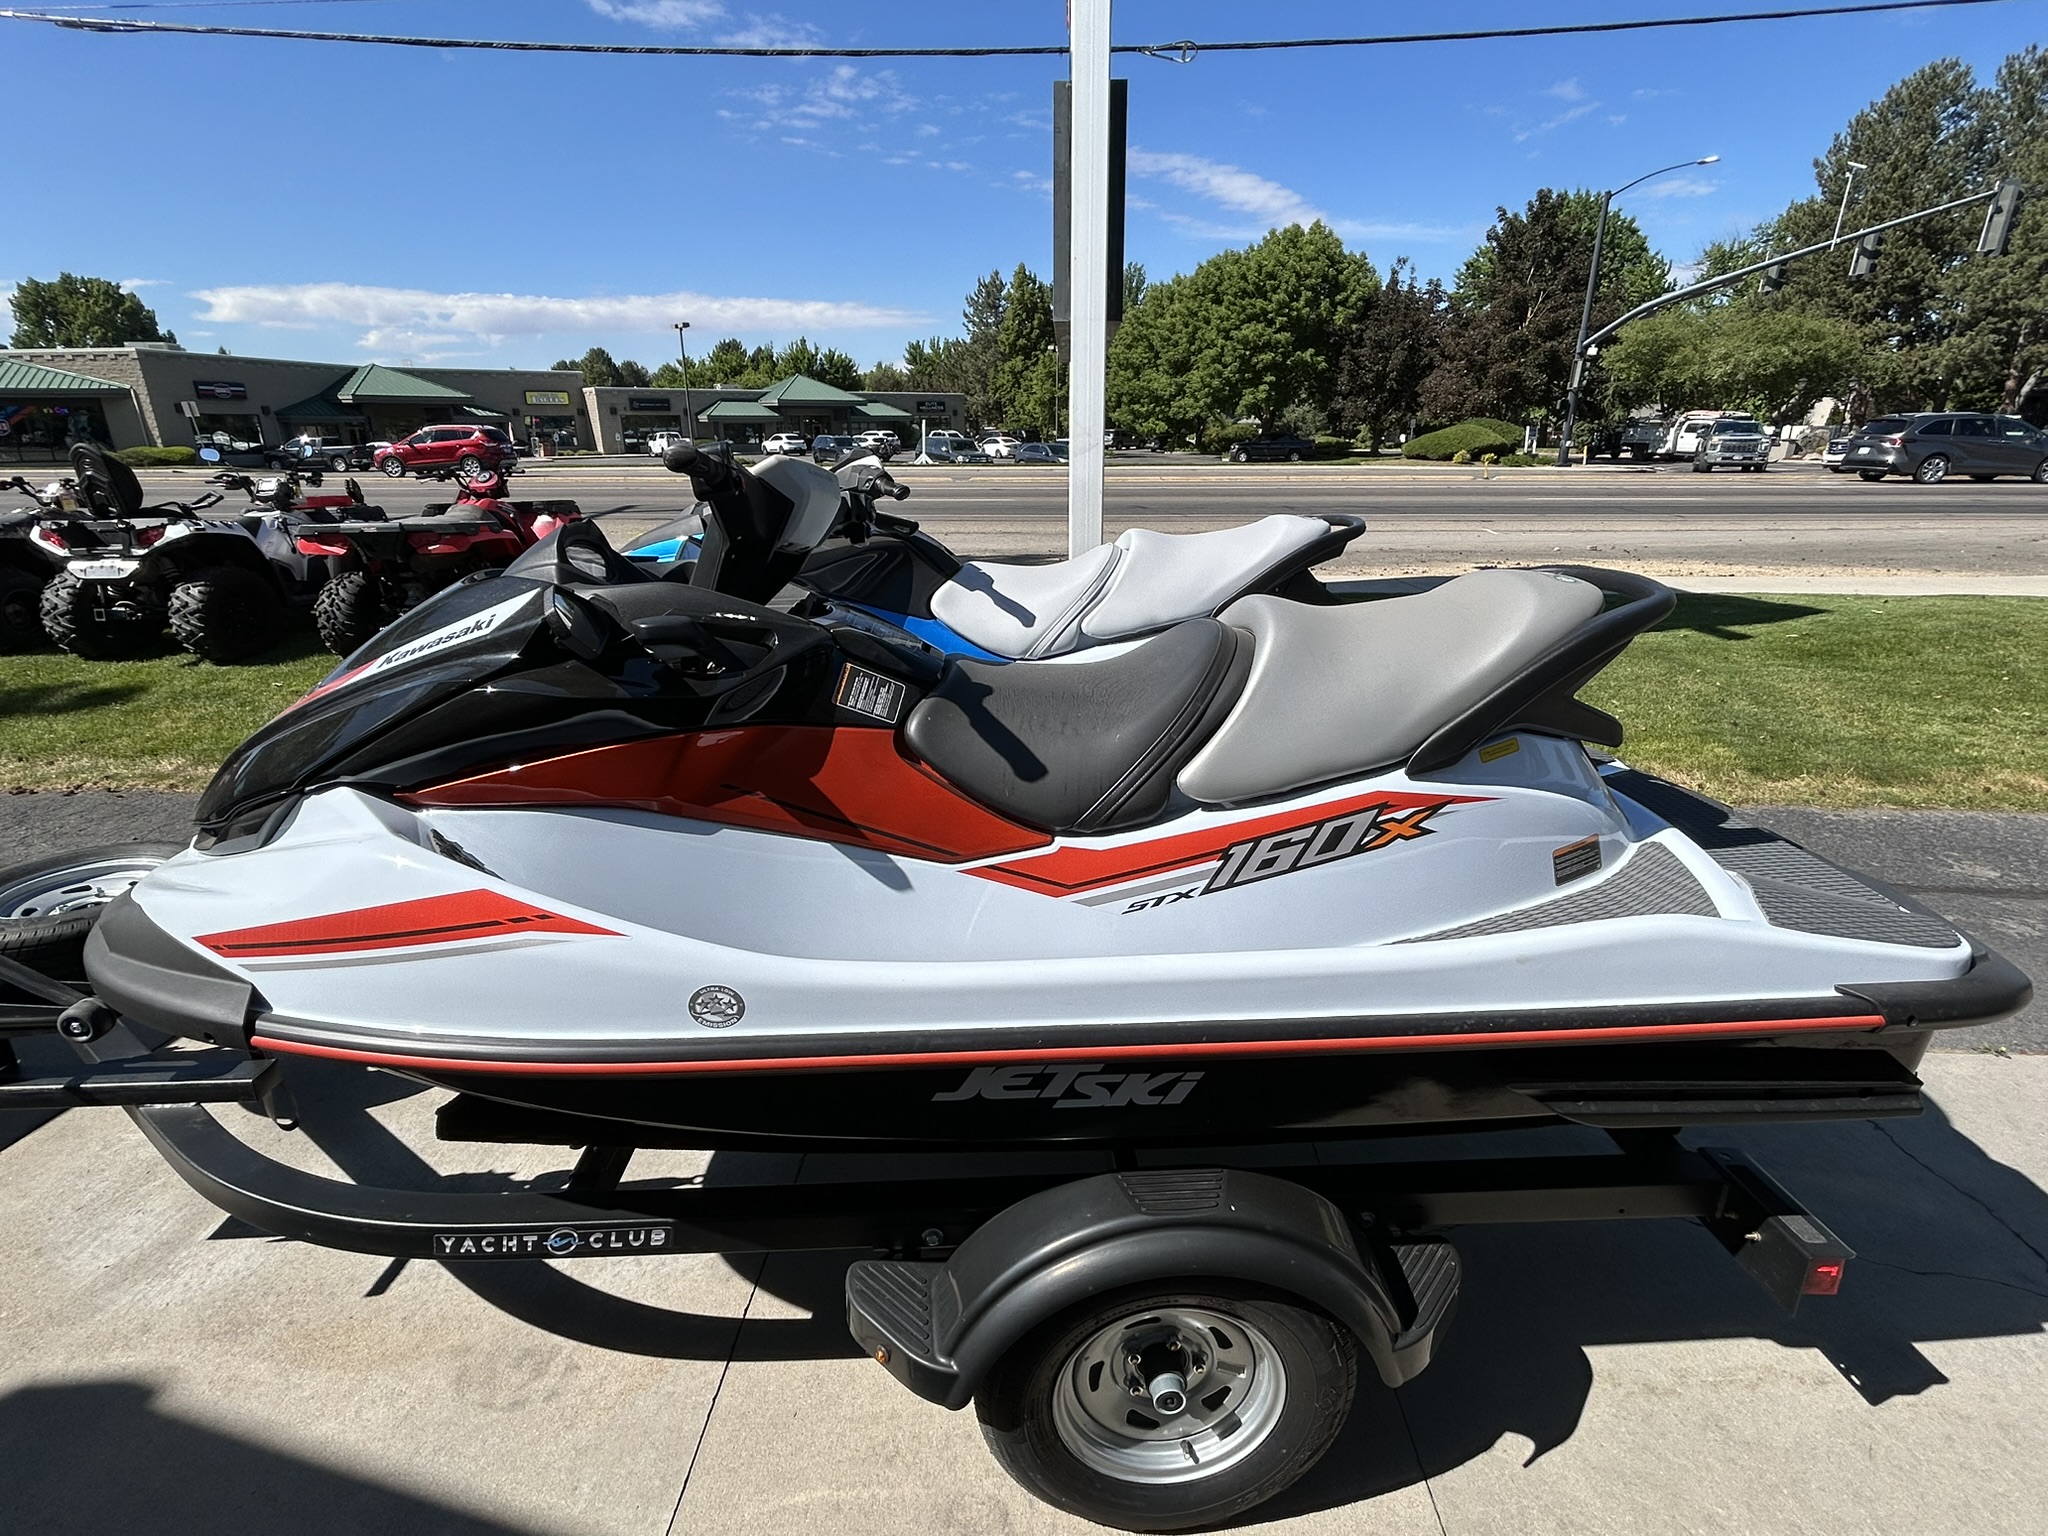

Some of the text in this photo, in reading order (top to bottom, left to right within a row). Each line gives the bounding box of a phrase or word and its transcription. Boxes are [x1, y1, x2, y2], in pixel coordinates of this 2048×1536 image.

[376, 613, 497, 669] Kawasaki
[1121, 799, 1456, 915] STX 160X
[699, 986, 735, 996] ULTRA LOW
[697, 1017, 738, 1028] EMISSION
[440, 1229, 666, 1253] YACHT CLUB
